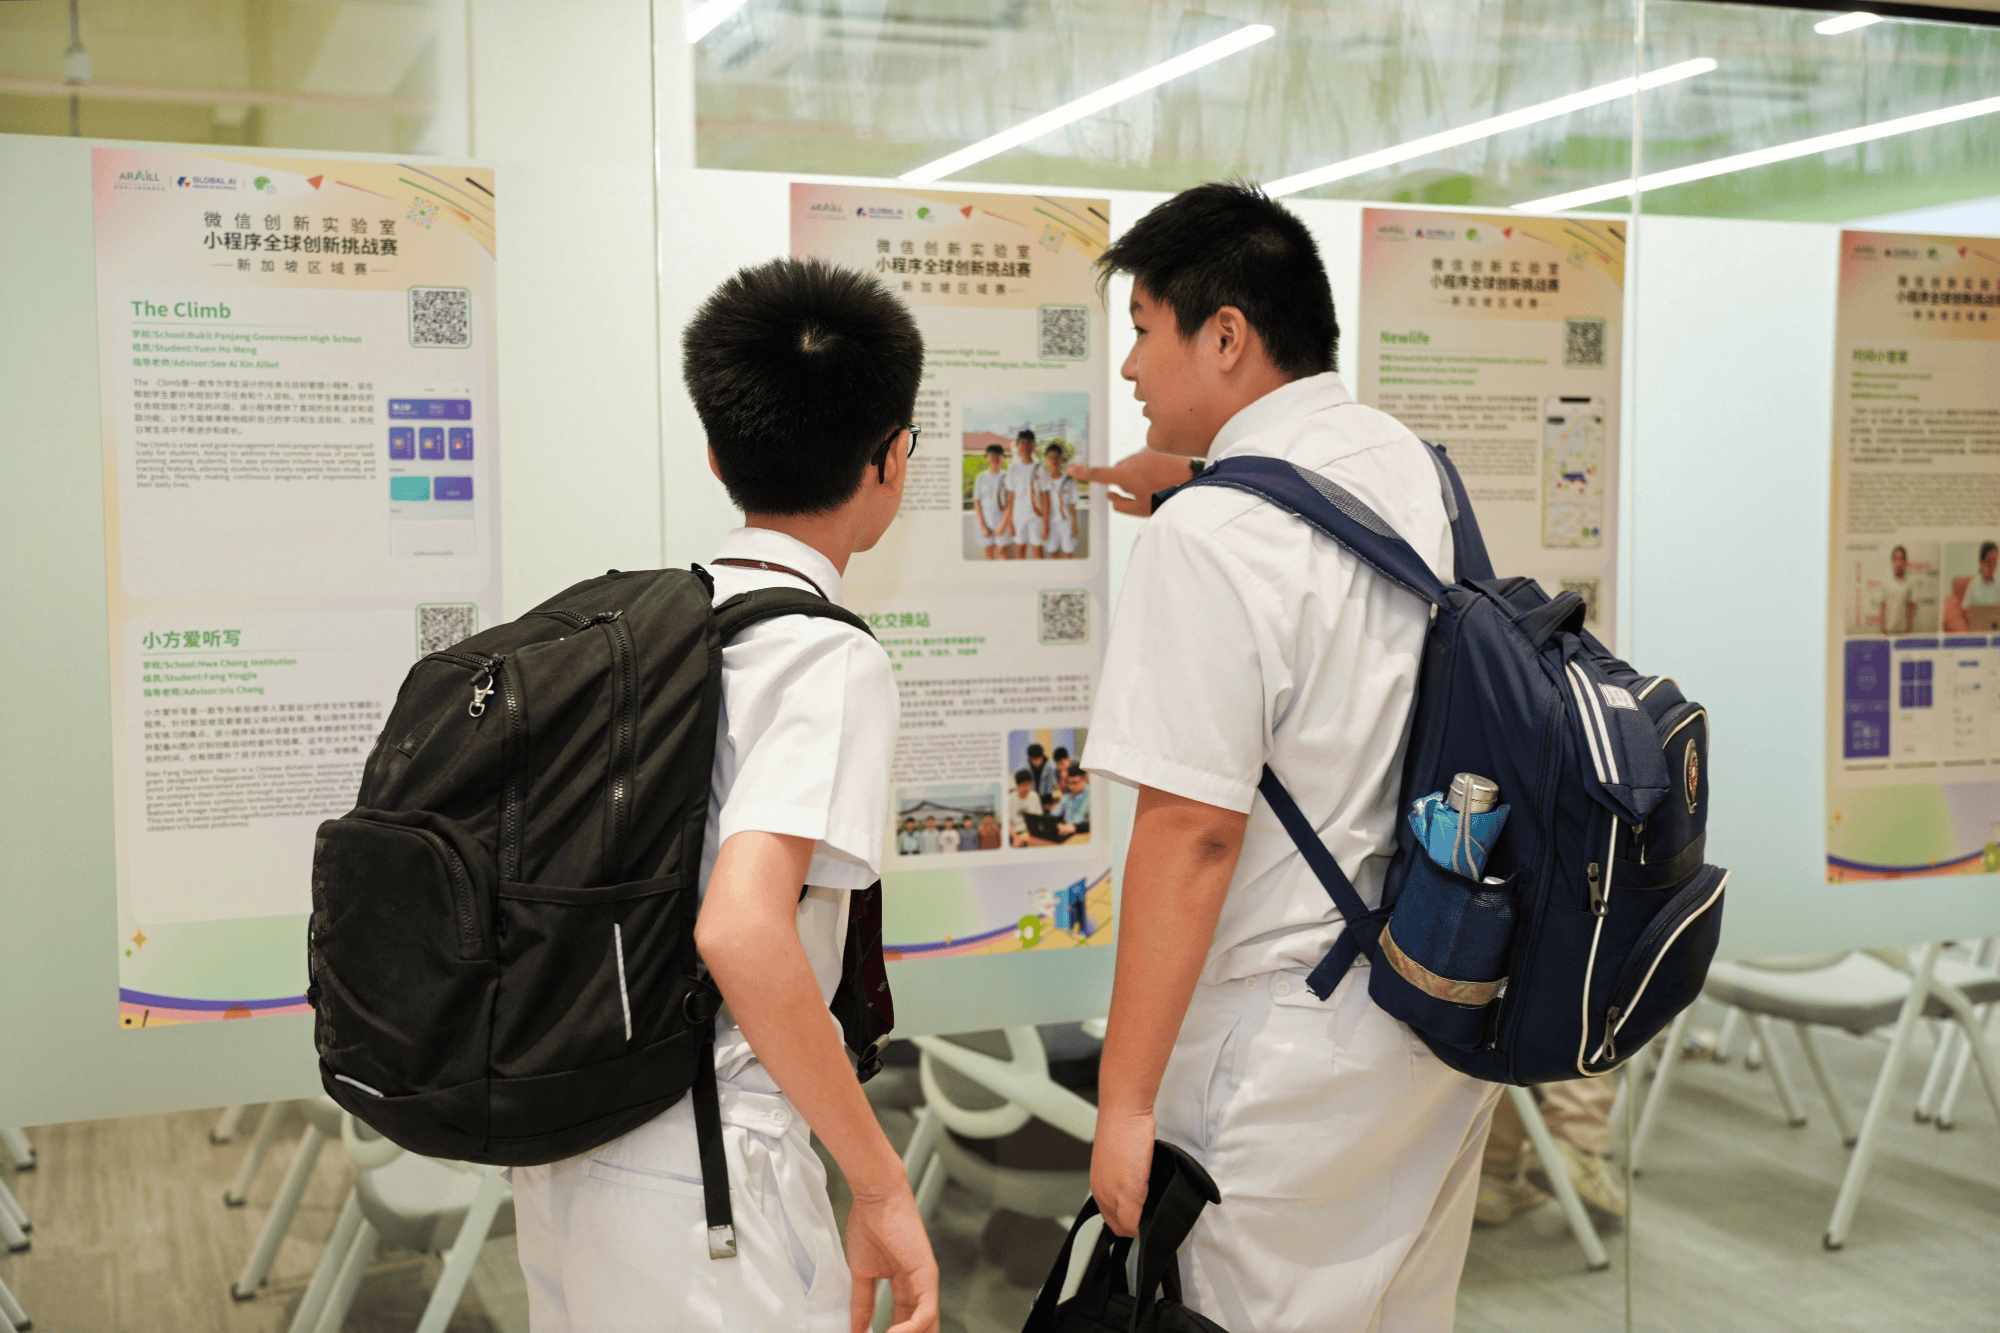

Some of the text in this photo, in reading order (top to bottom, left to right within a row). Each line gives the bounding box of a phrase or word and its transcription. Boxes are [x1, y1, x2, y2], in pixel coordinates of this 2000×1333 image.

[193, 176, 225, 184] GLOBAL
[204, 211, 396, 236] 微信创新实验室
[204, 231, 398, 258] 小程序全球创新挑战赛
[876, 238, 1031, 260] 微信创新实验室
[236, 258, 368, 278] 新加坡区域赛
[876, 257, 1032, 279] 小程序全球创新挑战赛
[132, 301, 232, 320] The Climb
[215, 333, 251, 343] Panjang
[253, 334, 308, 342] Government
[310, 334, 330, 344] High
[332, 335, 362, 344] School
[1380, 330, 1431, 345] Newlife
[134, 378, 148, 386] The
[142, 630, 242, 650] 小方爱听写
[220, 660, 248, 668] Chong
[250, 658, 297, 666] Institution
